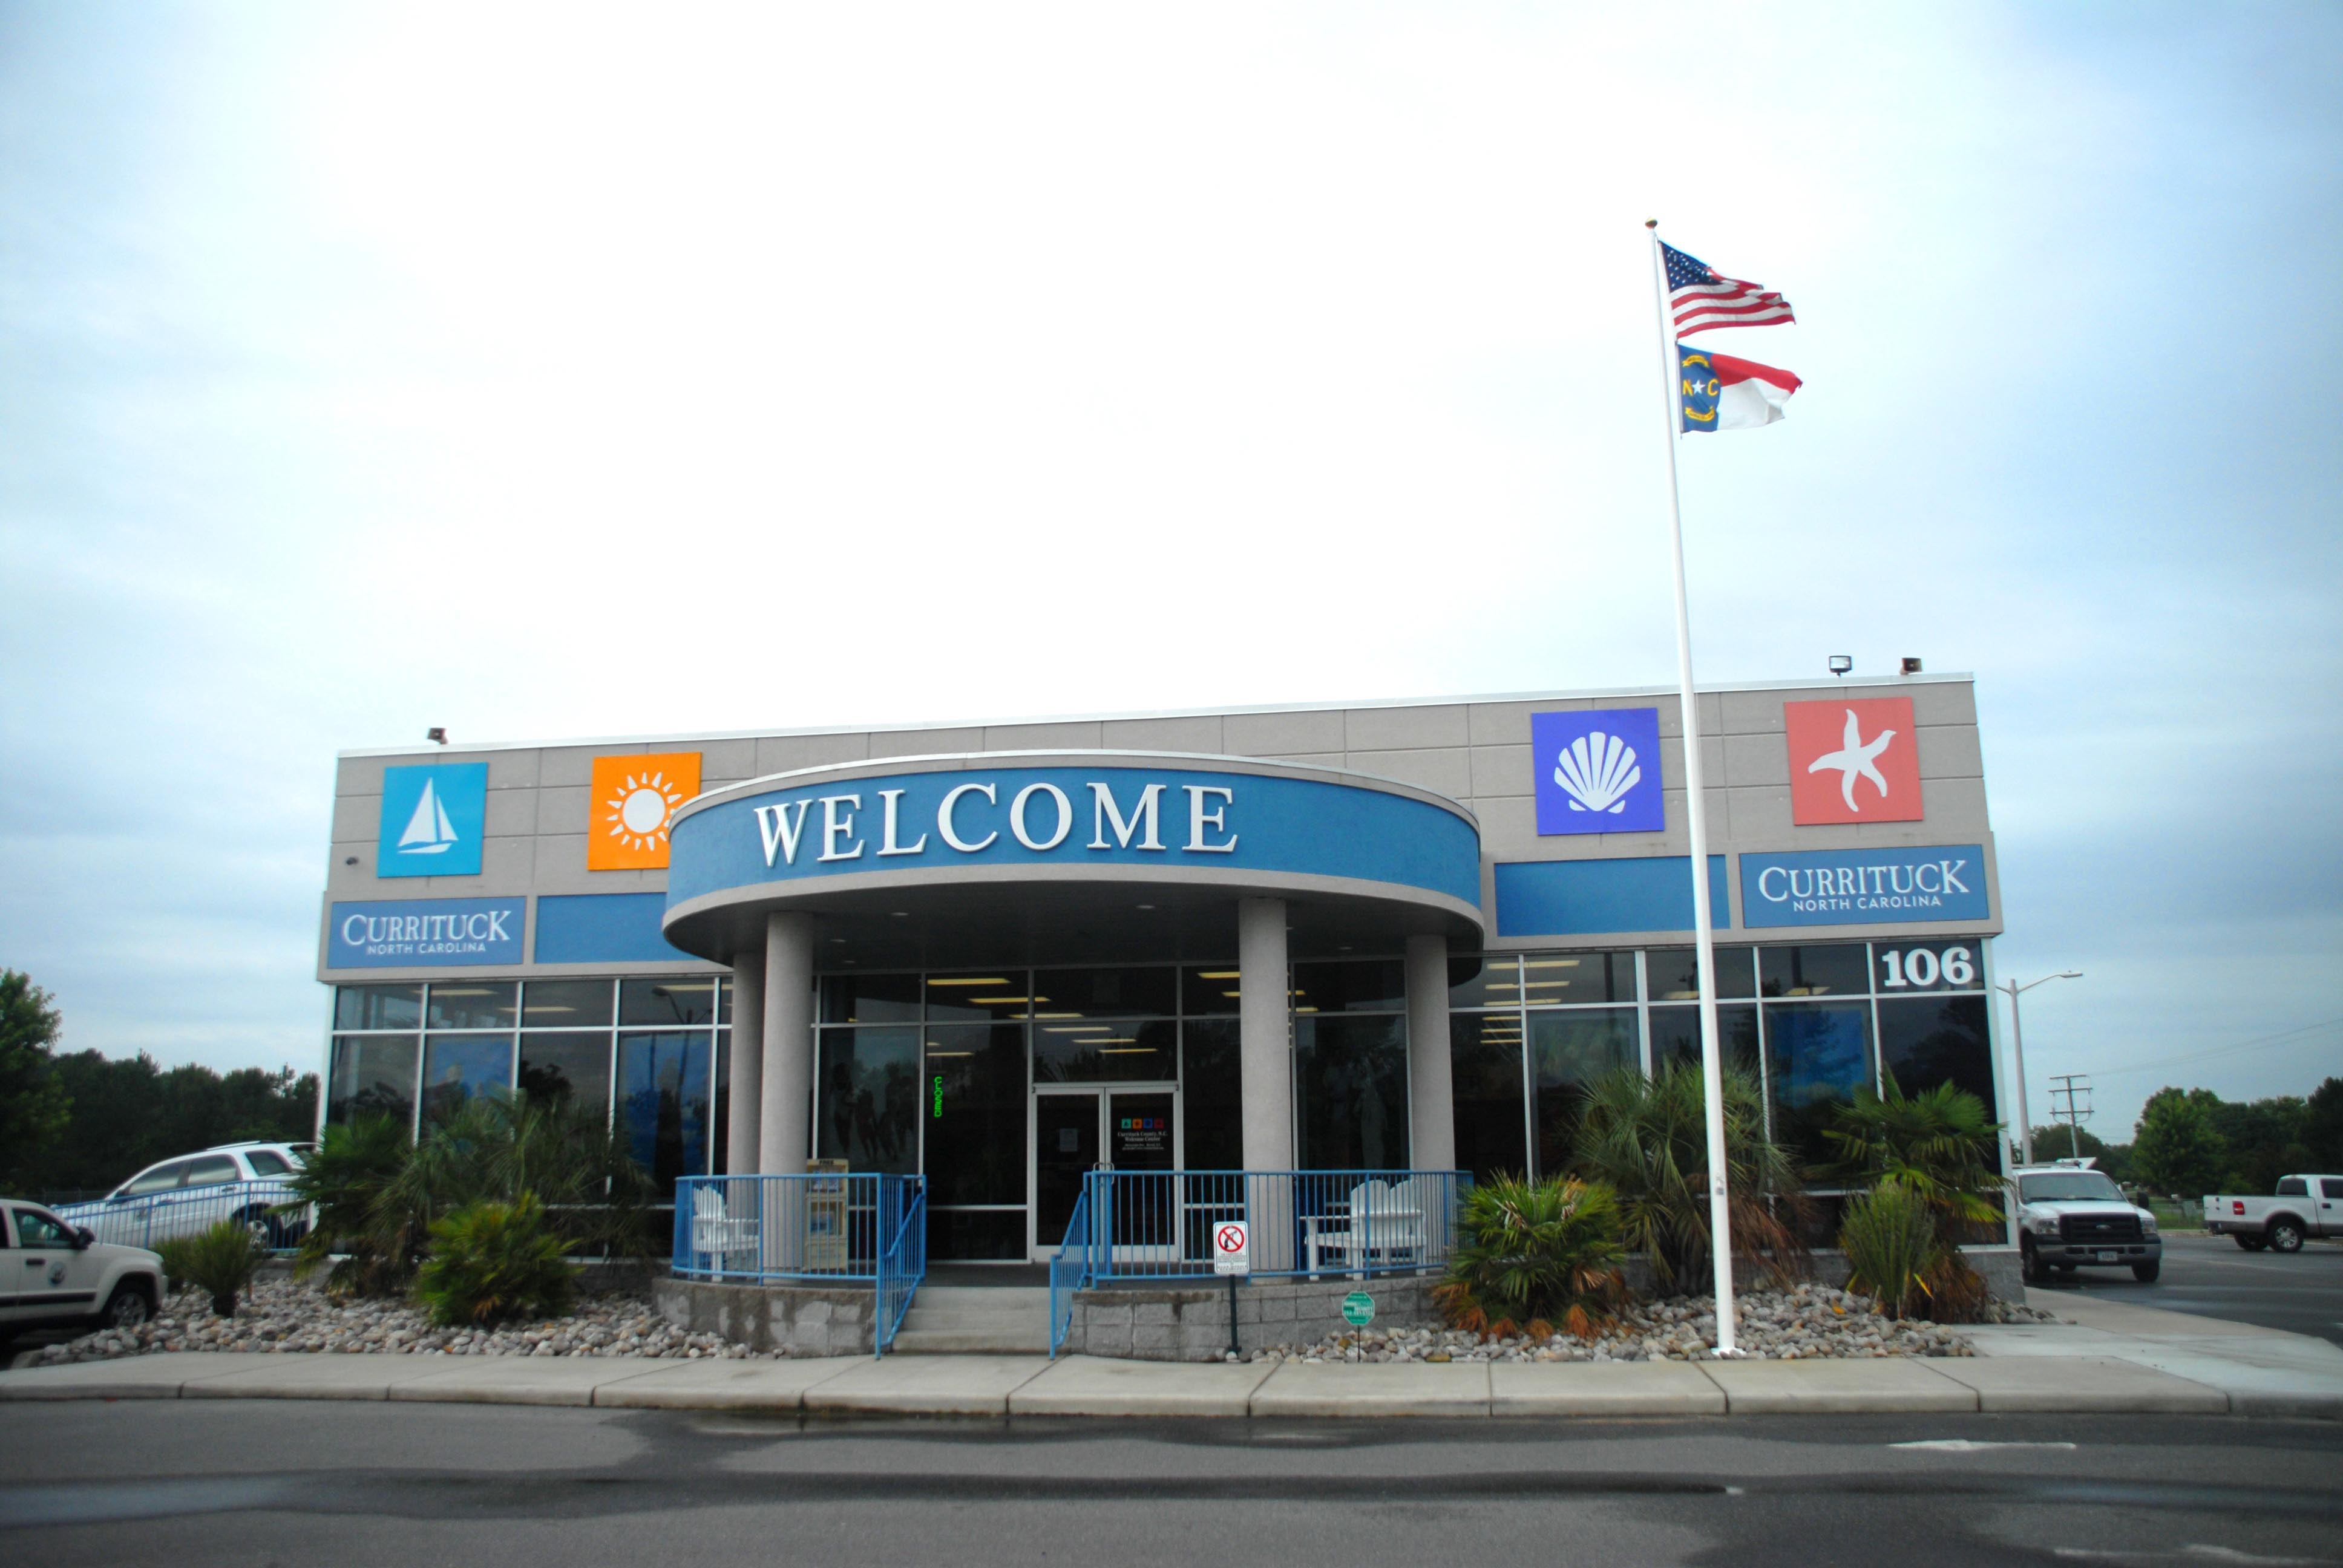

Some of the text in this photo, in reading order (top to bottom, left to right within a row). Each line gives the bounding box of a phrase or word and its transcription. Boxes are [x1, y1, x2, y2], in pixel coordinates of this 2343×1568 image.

[1682, 377, 1719, 396] N C
[753, 782, 1238, 868] WELCOME
[1757, 859, 1970, 902] CURRITUCK
[1793, 895, 1942, 912] NORTH CAROLINA
[342, 910, 512, 946] CURRITUCK
[367, 942, 487, 955] NORTH CAROLINA
[1882, 946, 1974, 987] 106
[934, 1076, 943, 1118] CLOSED
